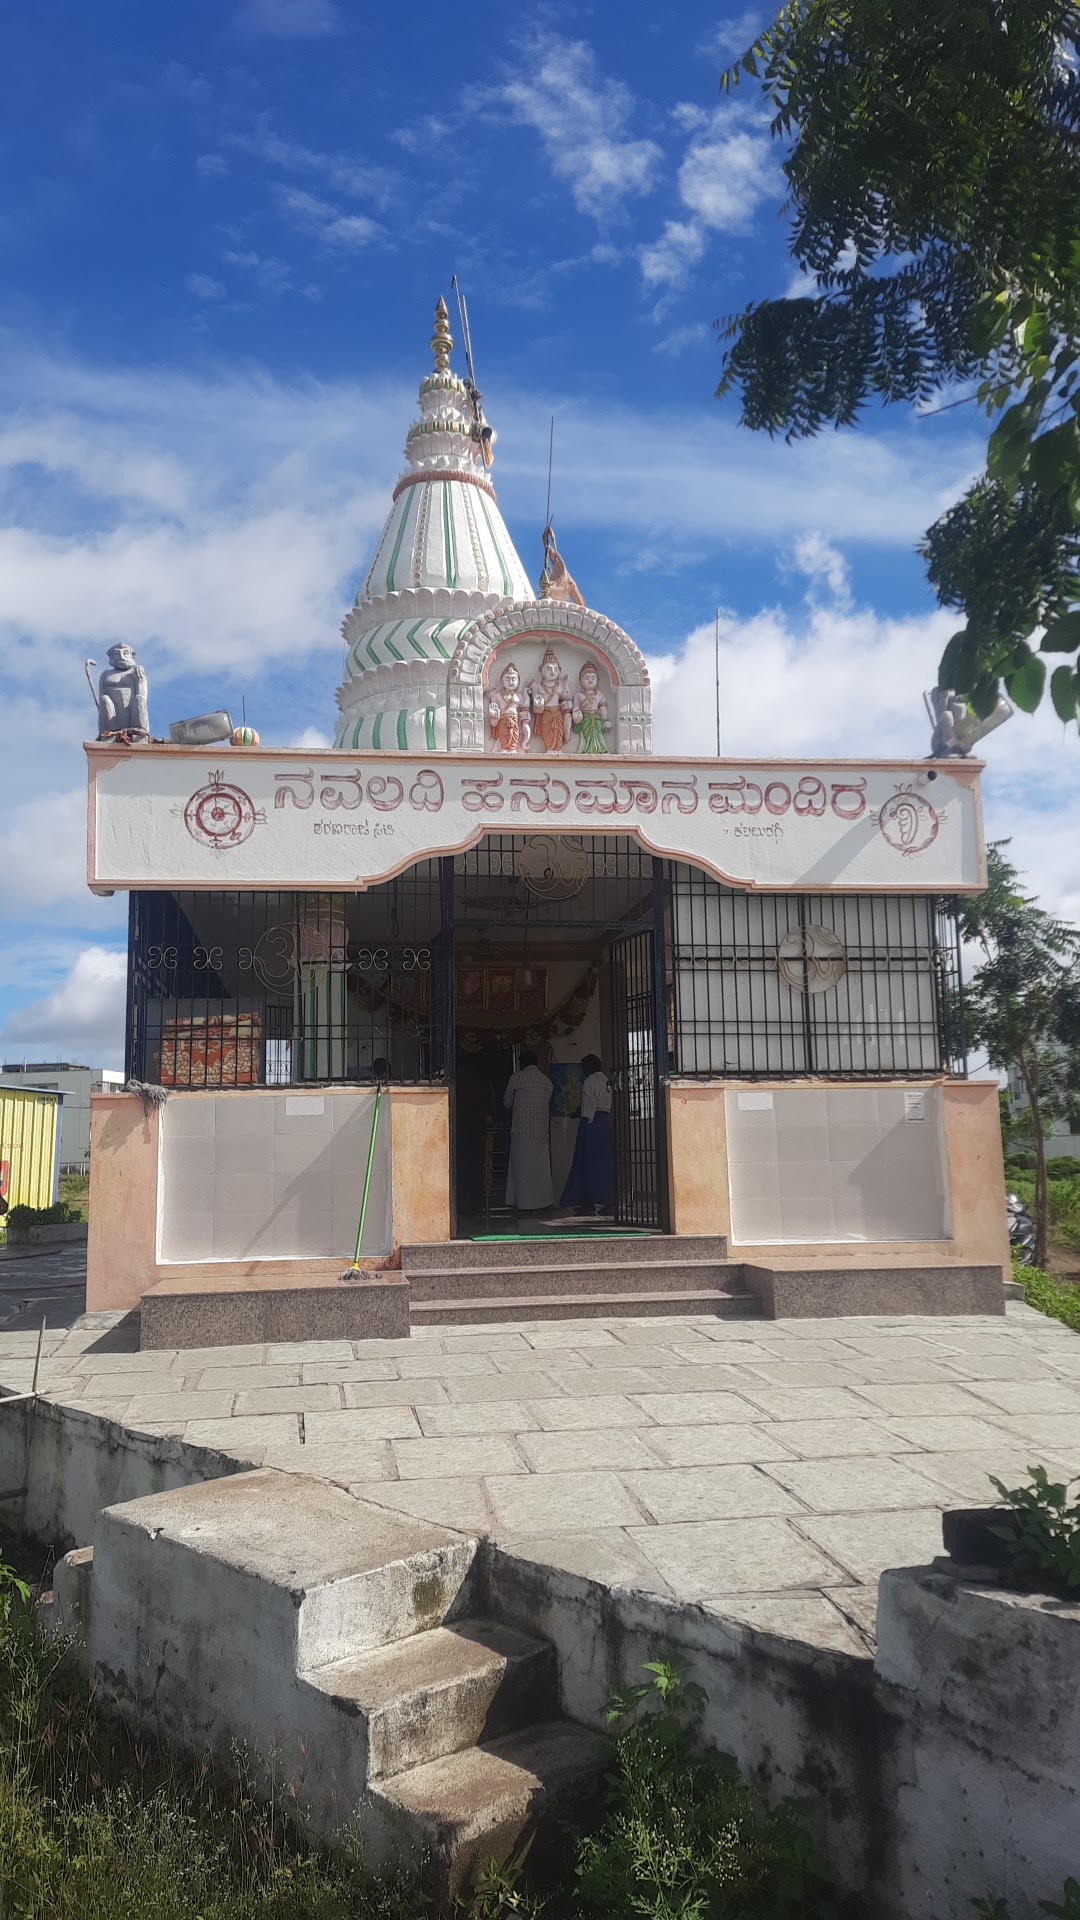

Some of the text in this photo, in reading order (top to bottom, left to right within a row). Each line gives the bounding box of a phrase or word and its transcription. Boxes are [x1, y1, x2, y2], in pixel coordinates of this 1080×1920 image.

[274, 767, 867, 820] ನವಲದಿ ಹನುಮಾನ ಮಂದಿರ
